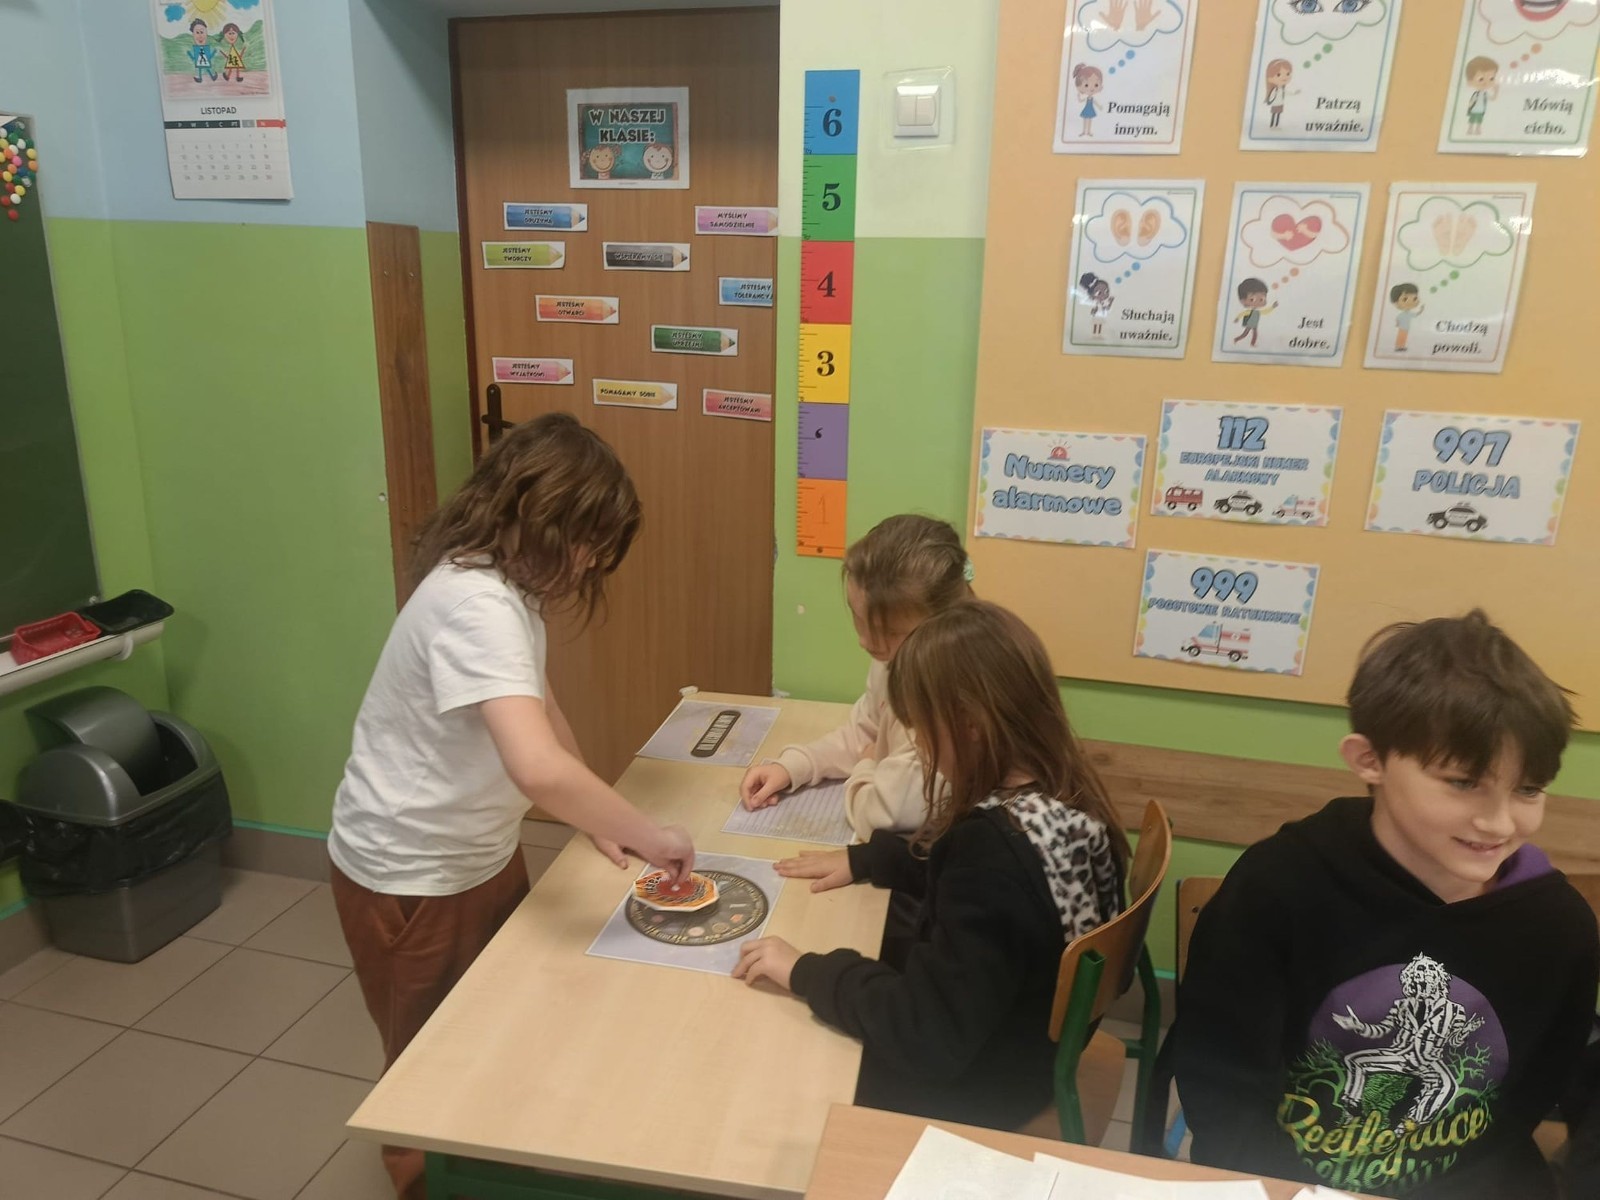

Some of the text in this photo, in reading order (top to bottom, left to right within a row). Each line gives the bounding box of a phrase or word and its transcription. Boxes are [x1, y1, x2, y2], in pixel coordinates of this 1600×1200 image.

[200, 107, 237, 115] LISTOPAD
[1107, 102, 1170, 118] Pomagają
[1315, 97, 1361, 113] Patrzą
[1523, 98, 1574, 115] Mówią
[588, 108, 666, 125] W NASZEJ
[822, 108, 842, 137] 6
[1114, 123, 1158, 137] innym.
[1305, 119, 1364, 133] uważnie.
[1524, 121, 1566, 135] cicho.
[600, 129, 655, 143] KLASIE:
[821, 183, 841, 211] 5
[817, 271, 836, 297] 4
[1121, 308, 1175, 323] Słuchają
[1297, 316, 1325, 329] Jest
[1120, 328, 1173, 342] uważnie.
[1435, 319, 1488, 336] Chodzą
[1289, 336, 1331, 350] dobre.
[1432, 341, 1482, 355] powoli.
[817, 351, 835, 376] 3
[1217, 415, 1270, 451] 112
[1432, 426, 1512, 467] 997
[1179, 451, 1310, 471] EUROPEJSKI NUMER
[1004, 453, 1116, 489] Numery
[1204, 469, 1281, 486] ALARMOWY
[1412, 469, 1522, 499] POLICJA
[991, 486, 1123, 517] alarmowe
[1190, 567, 1259, 604] 999
[1147, 597, 1302, 626] POGOTOWIE RATUNKOWE
